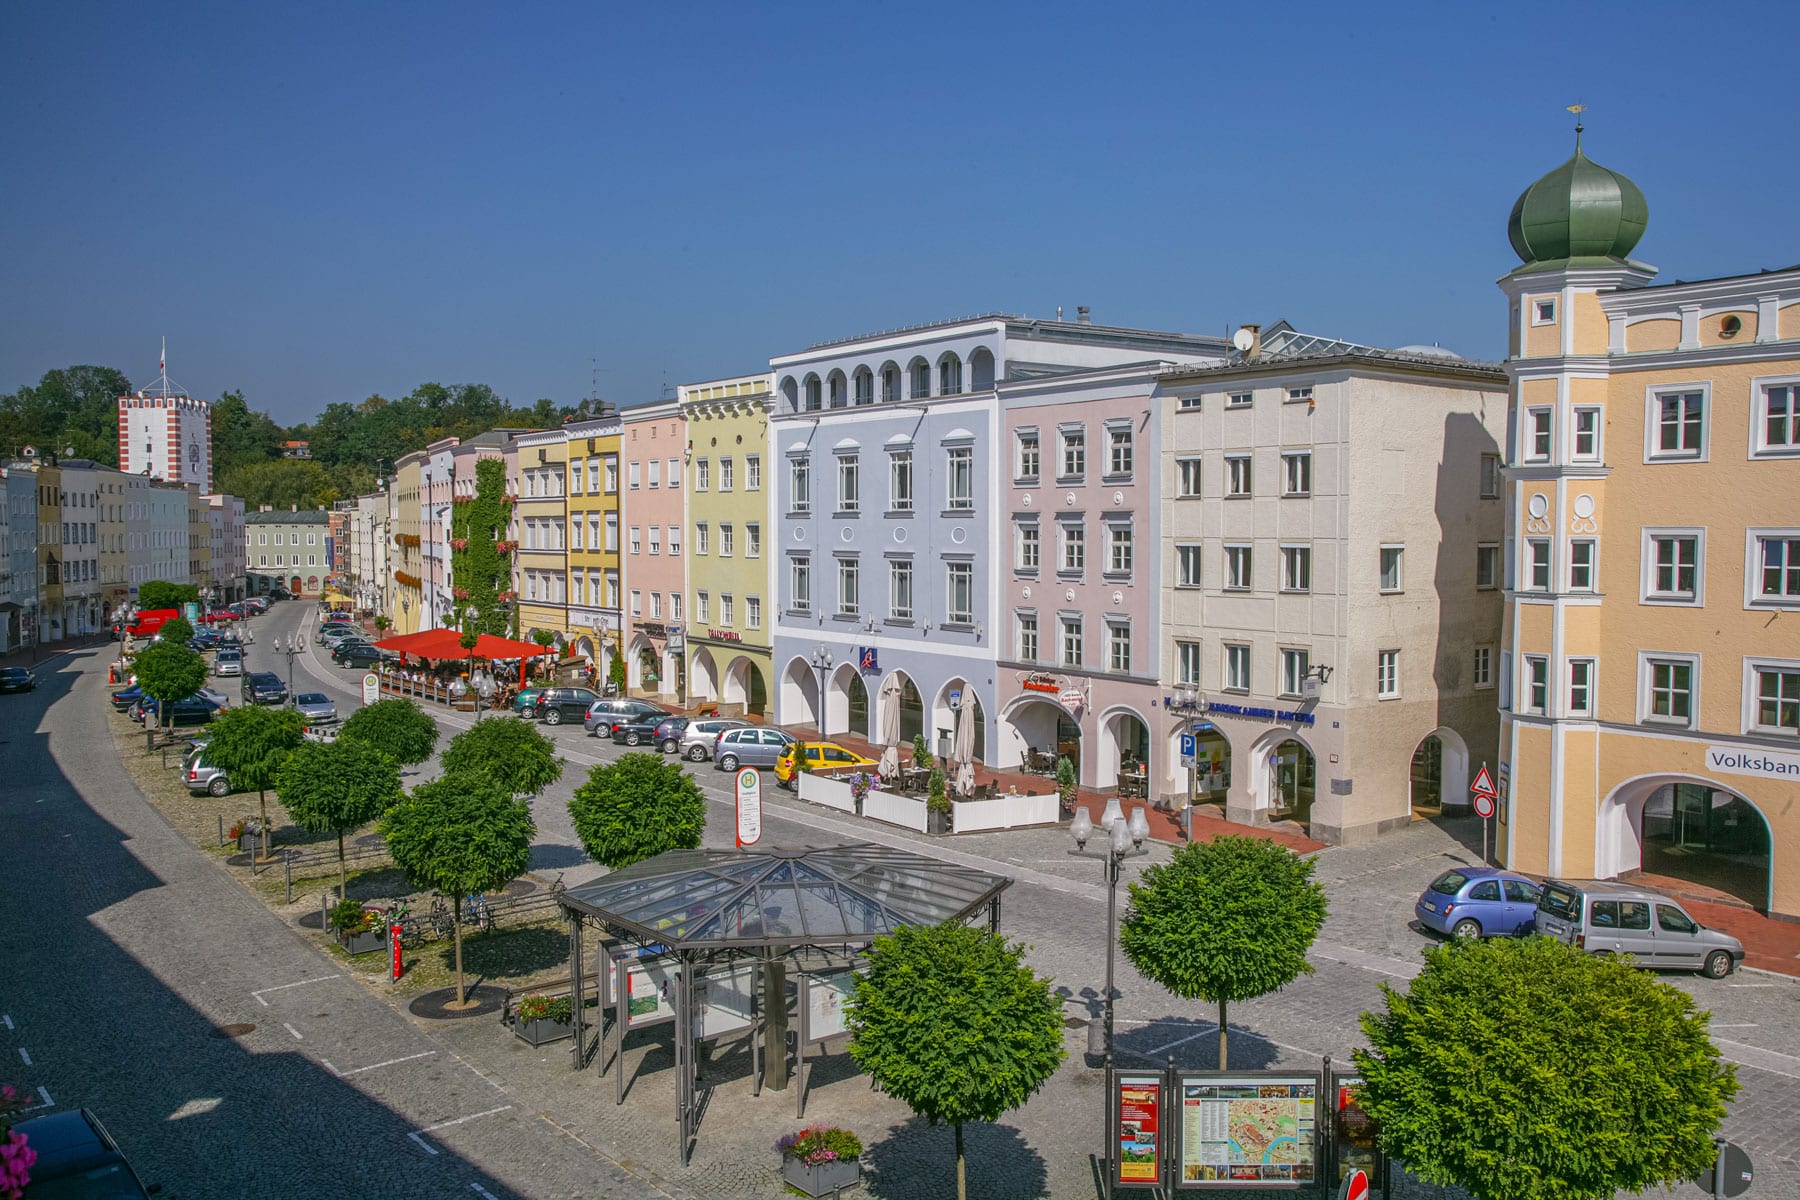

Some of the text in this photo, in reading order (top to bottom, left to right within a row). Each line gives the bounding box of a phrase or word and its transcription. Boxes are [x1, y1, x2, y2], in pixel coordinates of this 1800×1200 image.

[1183, 737, 1192, 753] P
[1711, 752, 1800, 775] Volksban
[744, 775, 752, 785] H
